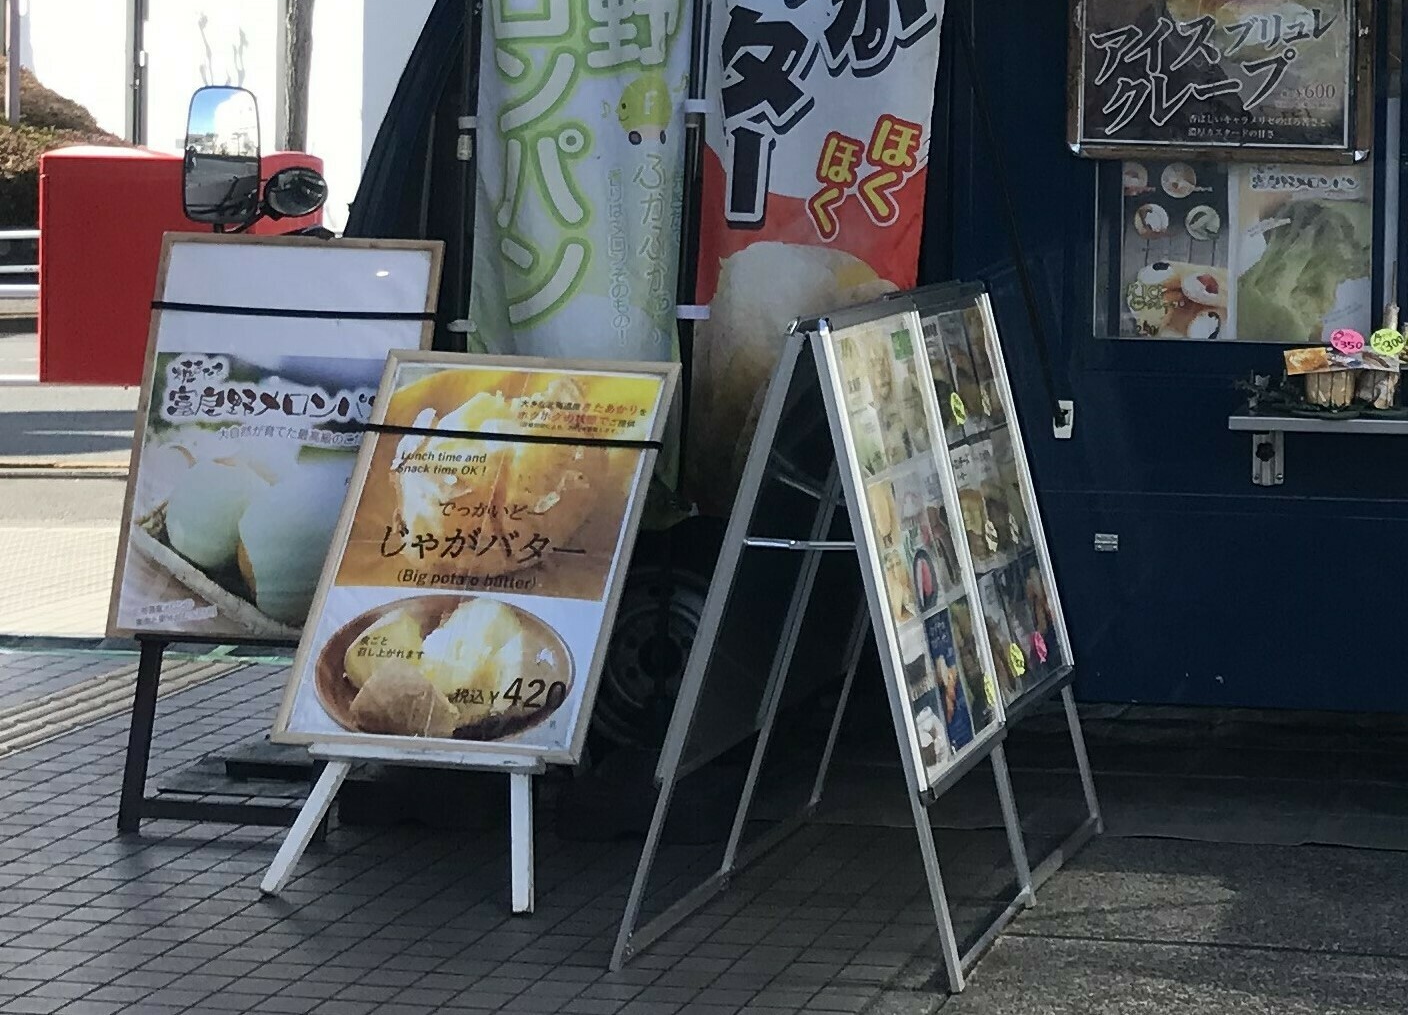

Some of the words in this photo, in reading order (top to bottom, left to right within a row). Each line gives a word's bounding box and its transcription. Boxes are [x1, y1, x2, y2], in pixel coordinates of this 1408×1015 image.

[1090, 15, 1221, 85] アイス
[1103, 47, 1299, 135] クレープ
[401, 451, 434, 461] Lunch
[437, 452, 461, 463] time
[465, 453, 487, 463] and
[433, 465, 458, 475] time
[380, 525, 587, 564] じゃがバター
